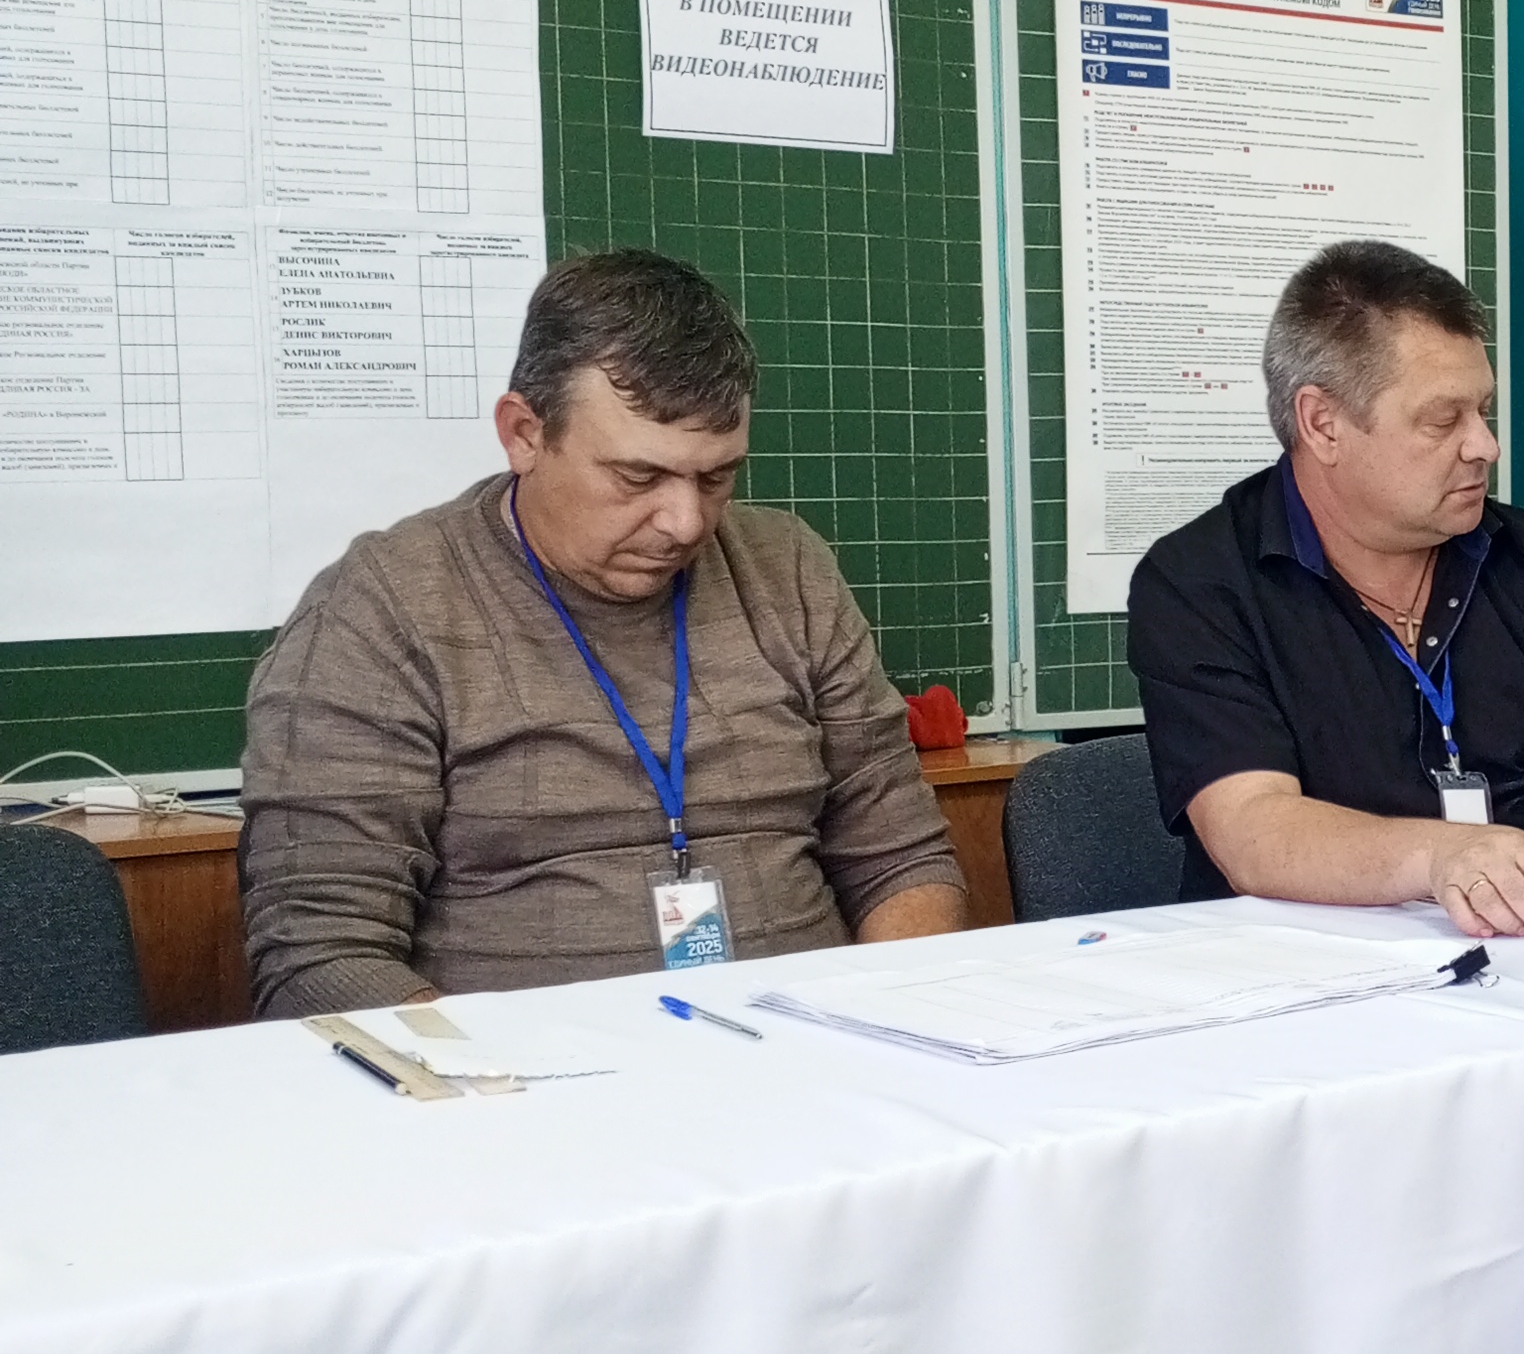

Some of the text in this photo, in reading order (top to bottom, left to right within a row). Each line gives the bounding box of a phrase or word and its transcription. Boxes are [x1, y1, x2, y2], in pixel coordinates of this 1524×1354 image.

[718, 29, 819, 53] ВЕДЕТСЯ
[651, 54, 887, 90] ВИДЕОНАБЛЮДЕНИЕ
[279, 256, 340, 266] ВЫСОЧИНА
[318, 270, 395, 280] АНАТОЛЬЕВНА
[282, 300, 392, 310] АРТЕМ НИКОЛАЕВИЧ
[321, 332, 392, 340] ВИКТОРОВИЧ
[284, 362, 416, 371] РОМАН АЛЕКСАНДРОВИЧ
[687, 940, 723, 957] 2025
